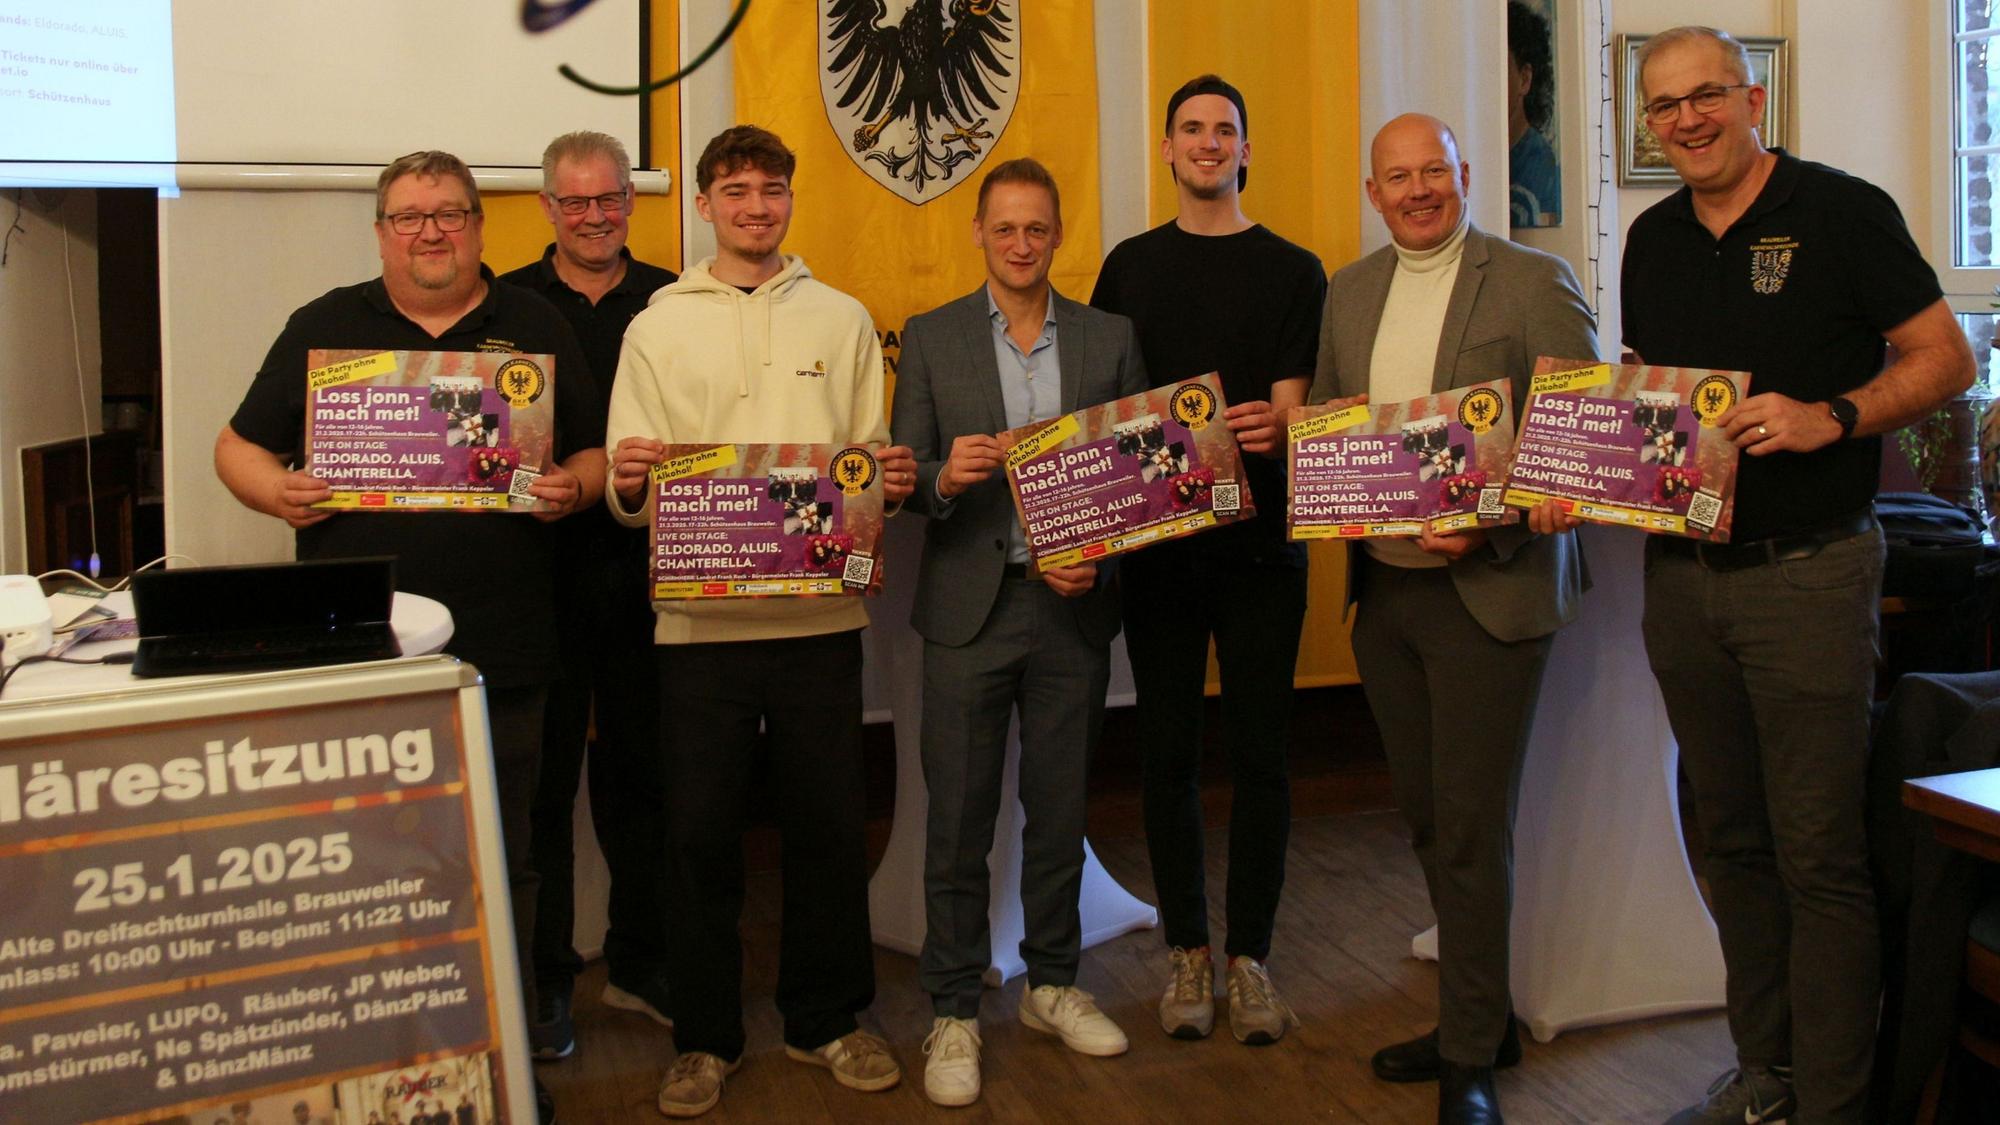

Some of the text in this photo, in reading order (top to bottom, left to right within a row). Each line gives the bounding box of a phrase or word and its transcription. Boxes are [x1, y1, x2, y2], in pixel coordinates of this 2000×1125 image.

[1, 50, 139, 75] Tickets nur online über
[28, 90, 111, 106] Schützenhaus
[310, 358, 376, 378] Die Party ohne
[1575, 370, 1594, 378] ohne
[312, 373, 350, 387] Alkohol!
[1534, 382, 1569, 391] Alkohol!
[317, 388, 360, 403] Loss
[364, 388, 410, 408] jonn
[1534, 393, 1574, 411] Loss
[1574, 398, 1616, 417] jonn
[316, 404, 419, 420] mach met!
[1289, 412, 1352, 433] Die Party ohne
[1529, 412, 1623, 434] mach met!
[1018, 436, 1039, 451] Party
[1041, 425, 1060, 439] ohne
[1292, 426, 1328, 440] Alkohol!
[1010, 444, 1041, 466] Alkohol!
[1296, 441, 1338, 453] Loss
[1341, 438, 1384, 454] jonn
[1520, 442, 1587, 458] LIVE ON STAGE:
[314, 453, 443, 464] ELDORADO. ALUIS.
[654, 451, 717, 472] Die Party ohne
[1015, 458, 1056, 480] Loss
[1059, 446, 1101, 471] jonn
[1296, 451, 1393, 468] mach met!
[1517, 453, 1634, 480] ELDORADO. ALUIS.
[313, 468, 416, 479] CHANTERELLA.
[656, 466, 692, 480] Alkohol!
[1020, 456, 1113, 495] mach met!
[1513, 467, 1606, 490] CHANTERELLA.
[660, 481, 702, 496] Loss
[706, 480, 749, 500] jonn
[1296, 491, 1418, 504] ELDORADO. ALUIS.
[660, 496, 758, 512] mach met!
[1026, 496, 1093, 521] LIVE ON STAGE:
[1029, 493, 1147, 534] ELDORADO. ALUIS.
[1296, 504, 1392, 515] CHANTERELLA.
[696, 532, 728, 540] STAGE:
[1032, 514, 1126, 547] CHANTERELLA.
[658, 542, 781, 555] ELDORADO. ALUIS.
[657, 558, 756, 569] CHANTERELLA.
[73, 832, 353, 913] 25.1.2025
[0, 877, 424, 960] Alte Dreifachturnhalle Brauweiler
[88, 944, 161, 974] 10:00
[168, 938, 215, 960] Uhr
[237, 920, 331, 949] Beginn:
[338, 905, 403, 932] 11:22
[409, 899, 451, 921] Uhr
[32, 1020, 141, 1055] Paveier,
[148, 1002, 228, 1033] LUPO,
[243, 984, 338, 1016] Räuber,
[344, 974, 375, 998] JP
[381, 961, 461, 990] Weber,
[155, 1037, 192, 1060] Ne
[199, 1010, 347, 1054] Spätzünder,
[353, 986, 468, 1023] DänzPänz
[156, 1044, 313, 1089] & DänzMänz
